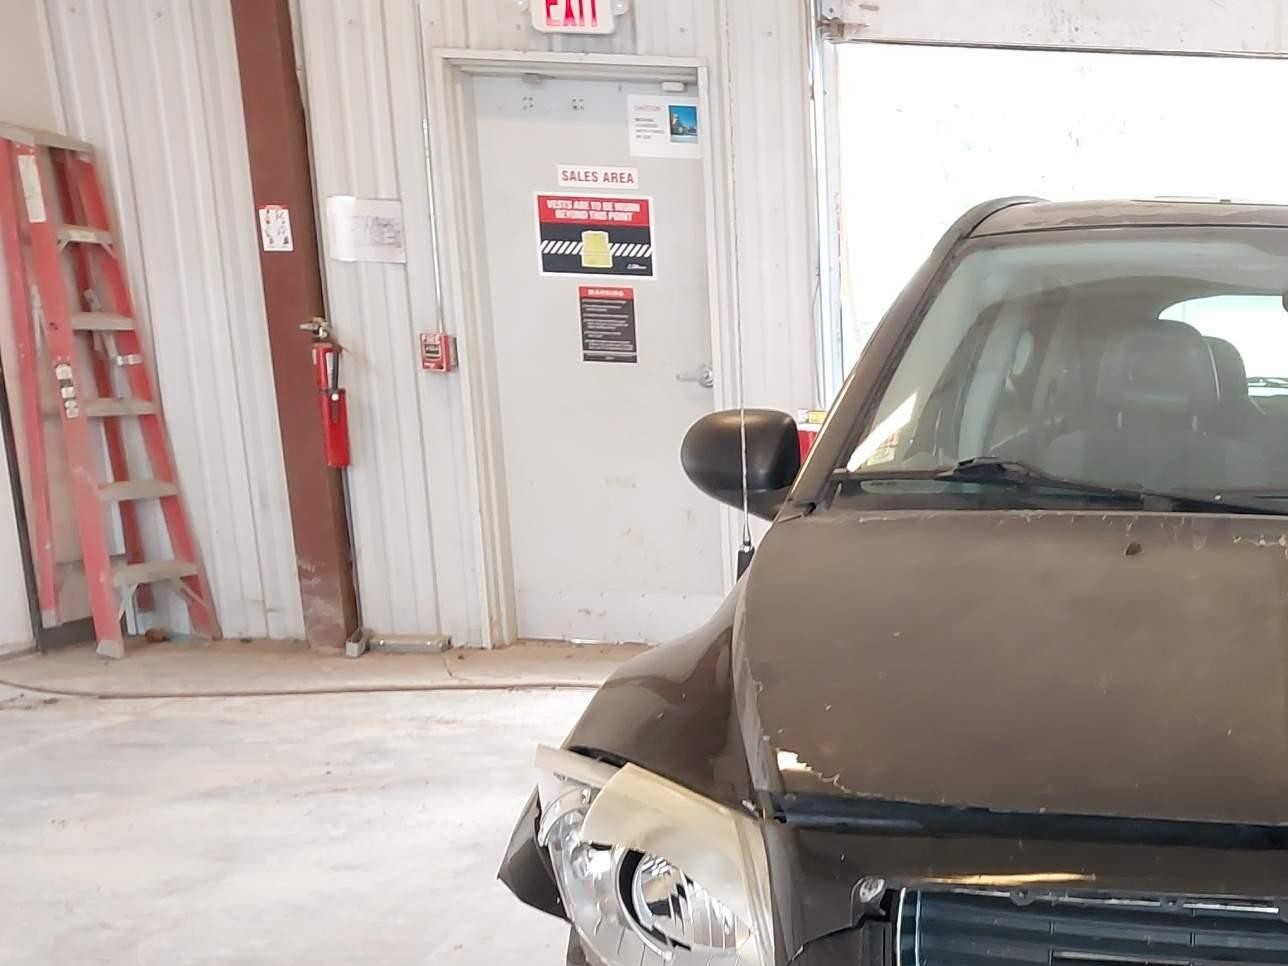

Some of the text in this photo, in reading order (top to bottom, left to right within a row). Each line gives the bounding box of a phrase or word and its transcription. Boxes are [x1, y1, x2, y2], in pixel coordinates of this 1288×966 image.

[561, 170, 635, 184] SALES AREA
[546, 199, 573, 209] VESTS
[573, 201, 590, 210] ARE
[591, 201, 601, 211] TO
[602, 202, 613, 211] BE
[589, 211, 607, 221] THIS
[608, 212, 633, 221] POINT
